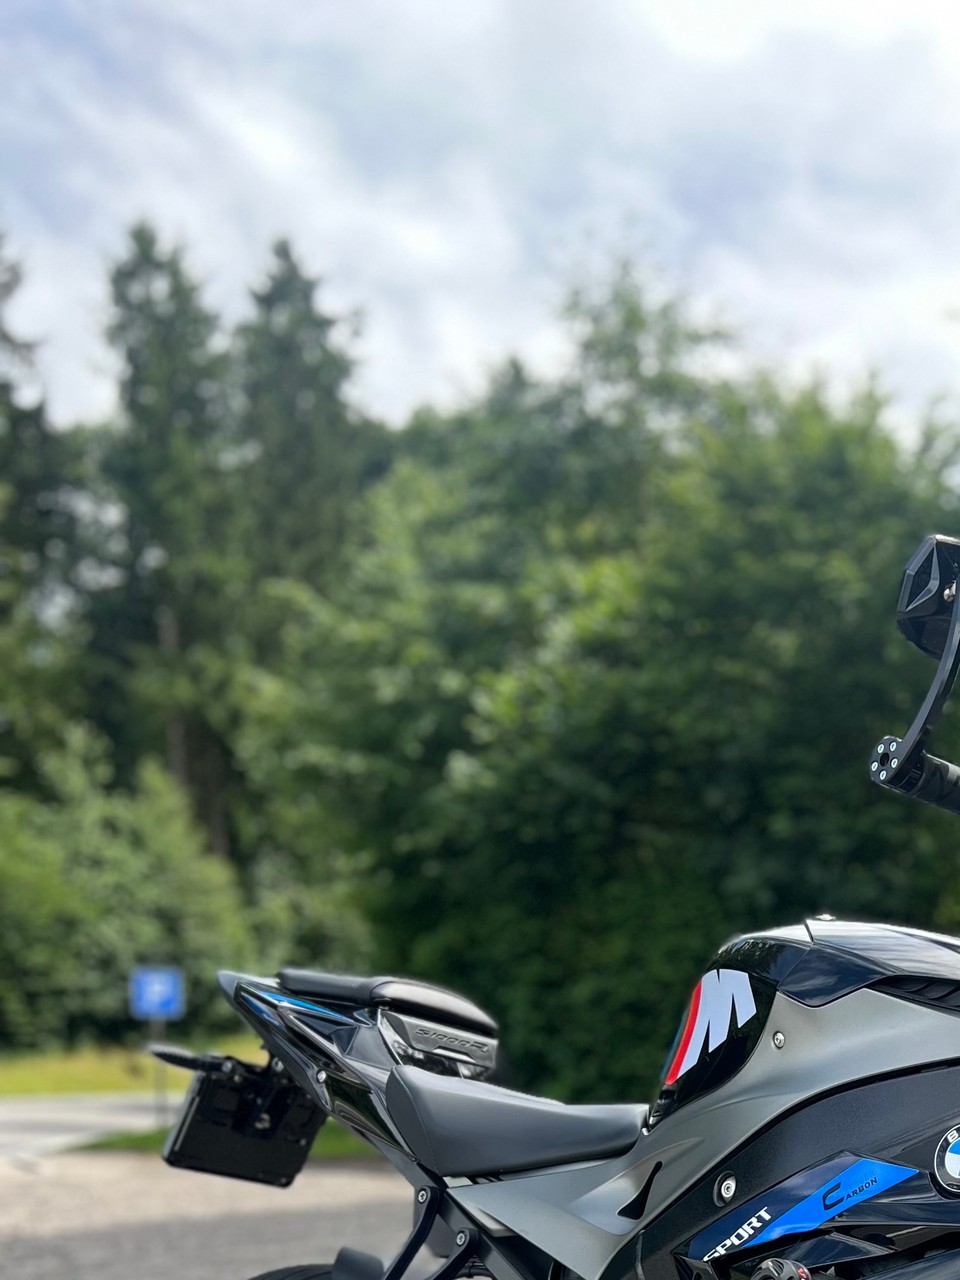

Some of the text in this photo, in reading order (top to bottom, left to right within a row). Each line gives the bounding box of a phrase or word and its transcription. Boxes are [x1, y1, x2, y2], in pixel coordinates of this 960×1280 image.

[415, 1028, 489, 1054] S1000R
[822, 1177, 878, 1211] CARBON
[702, 1206, 773, 1263] SPORT
